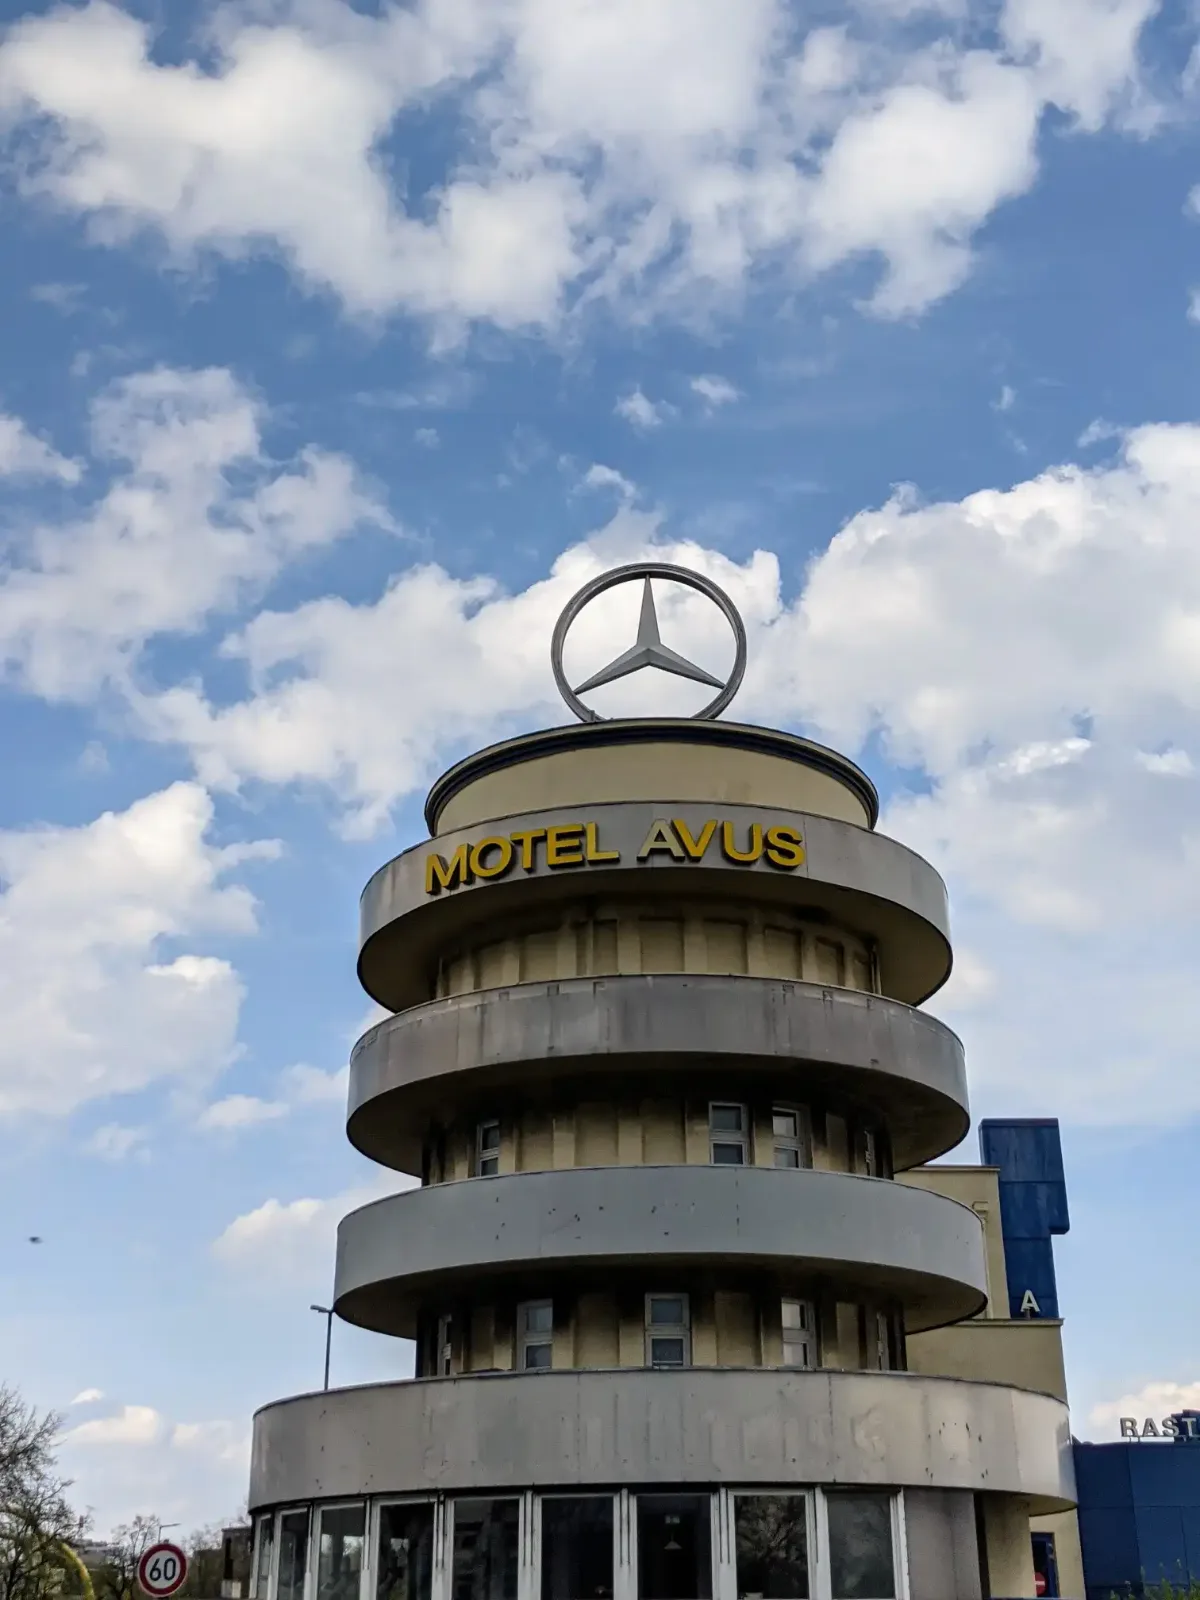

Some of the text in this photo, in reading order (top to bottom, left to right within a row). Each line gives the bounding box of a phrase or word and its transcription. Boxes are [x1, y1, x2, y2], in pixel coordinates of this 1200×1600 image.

[425, 818, 805, 896] MOTEL AVUS
[1020, 1289, 1040, 1313] A
[149, 1557, 176, 1582] 60
